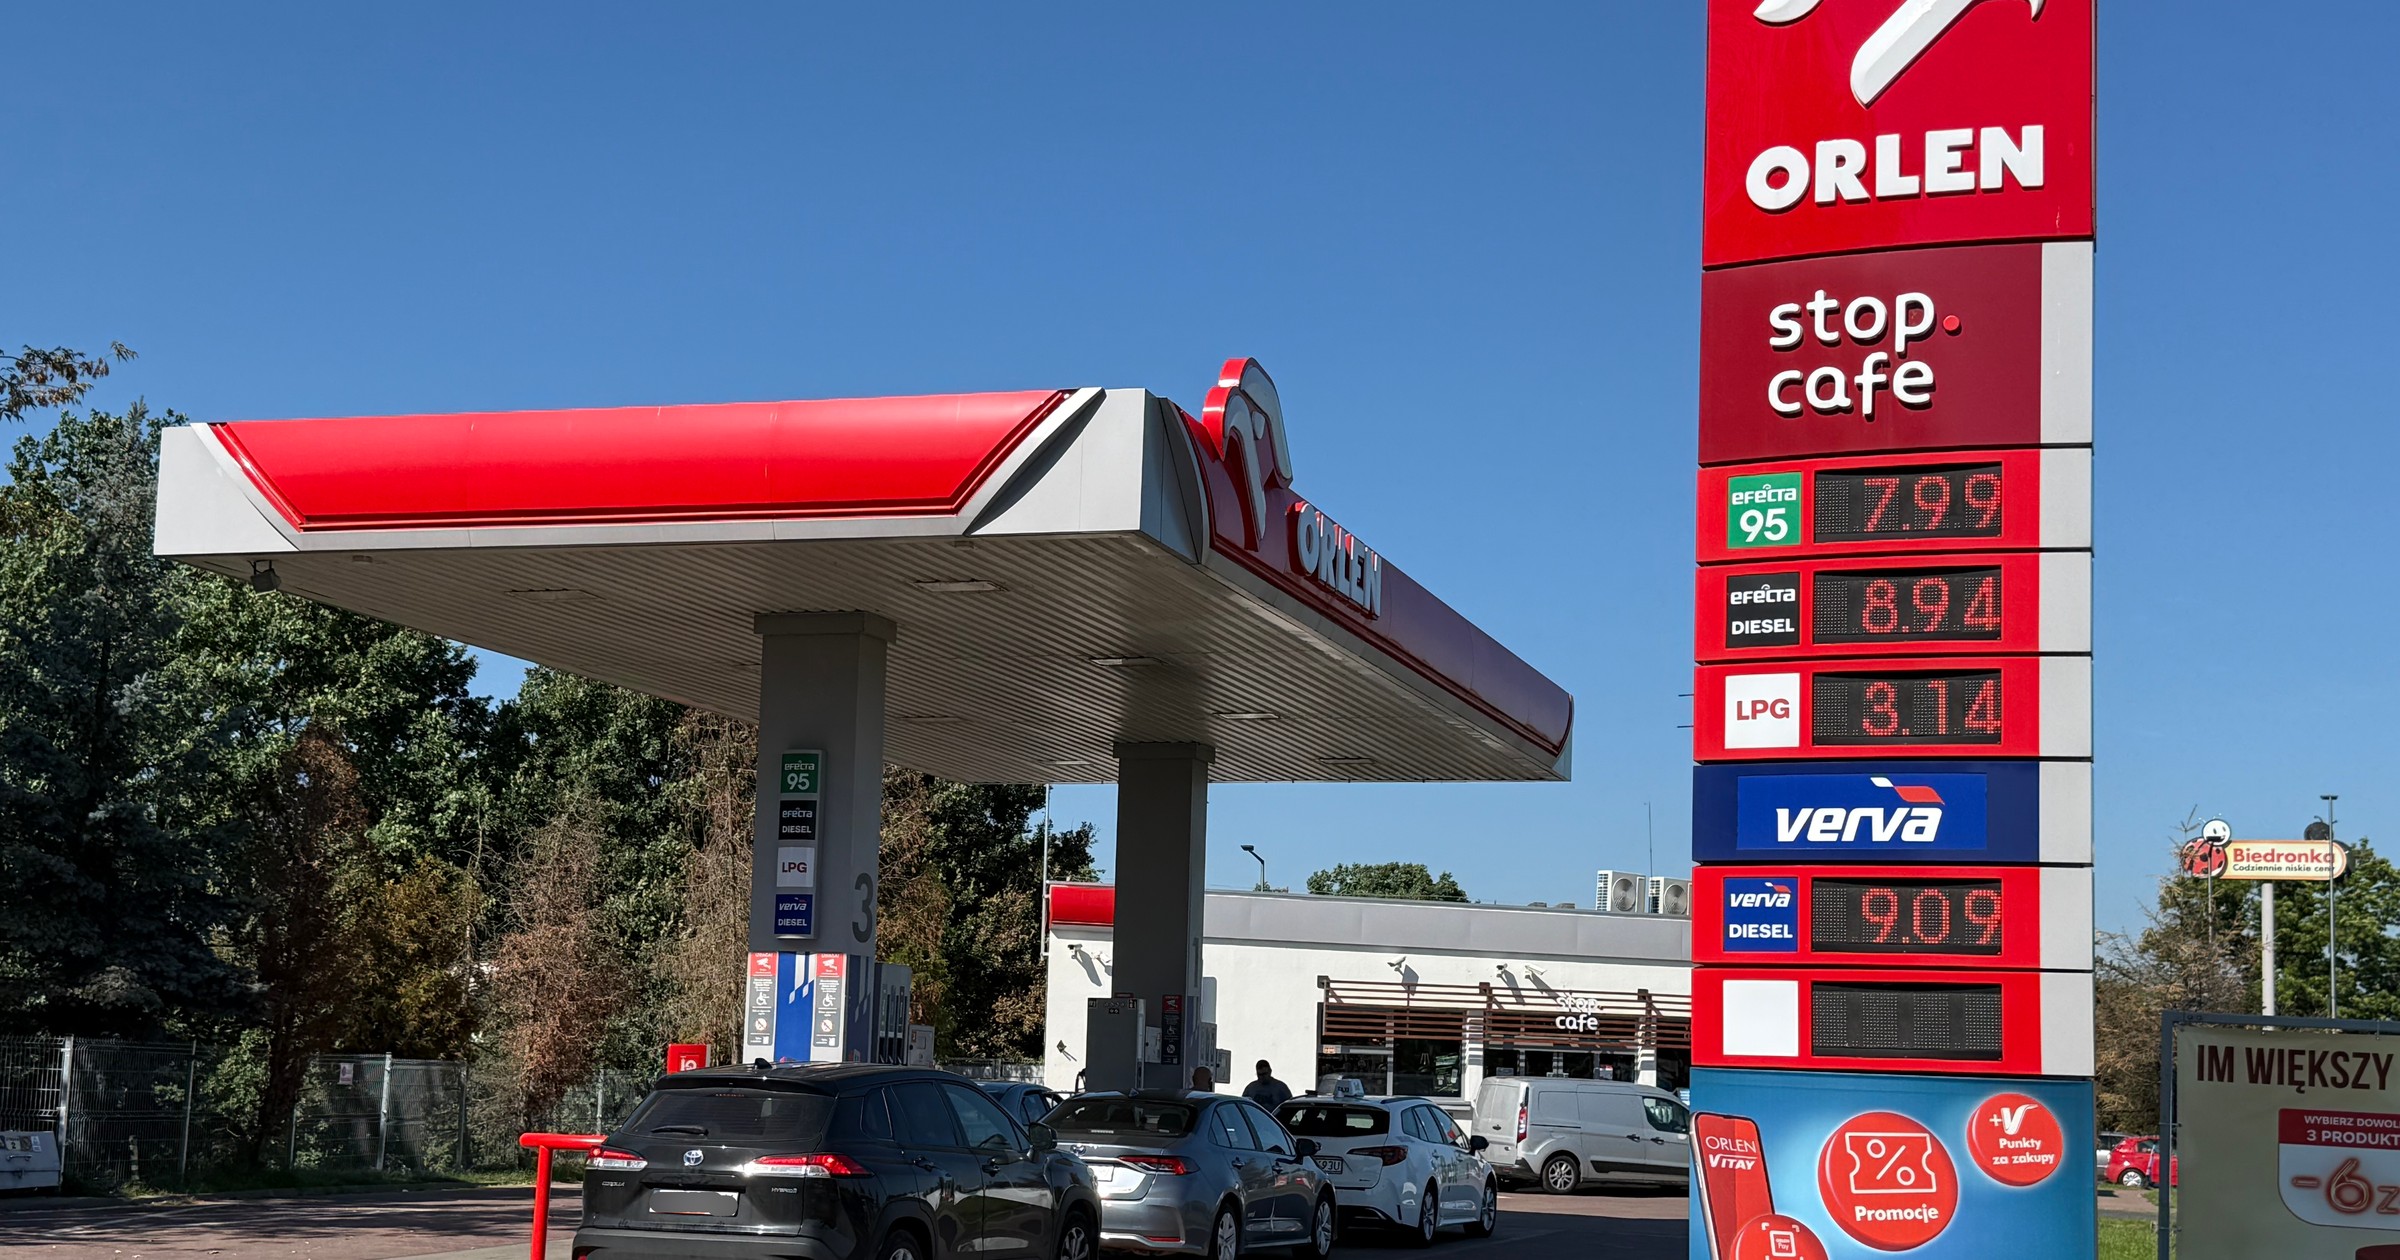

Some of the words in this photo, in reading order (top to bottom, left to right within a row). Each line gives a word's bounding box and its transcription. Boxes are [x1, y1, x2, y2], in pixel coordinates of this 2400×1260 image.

[1746, 125, 2044, 210] ORLEN
[1768, 352, 1934, 416] cafe
[1864, 474, 2000, 532] 7.99
[1739, 508, 1788, 542] 95
[1291, 502, 1381, 617] ORLEN
[1861, 577, 2000, 634] 8.94
[1731, 618, 1795, 635] DIESEL
[1736, 698, 1790, 721] LPG
[1861, 679, 2000, 736] 3.14
[787, 773, 809, 791] 95
[782, 825, 812, 834] DIESEL
[1776, 807, 1943, 843] verva
[2233, 848, 2335, 864] Biedronka
[782, 861, 808, 873] LPG
[2233, 863, 2282, 872] Codziennie
[2285, 863, 2311, 872] niskie
[779, 902, 807, 911] verva
[852, 872, 874, 943] 3
[1730, 891, 1792, 908] verva
[778, 918, 808, 926] DIESEL
[1861, 888, 2000, 945] 9.09
[1729, 923, 1793, 939] DIESEL
[1555, 1013, 1598, 1032] cafe
[2197, 1044, 2235, 1083] IM
[2245, 1047, 2394, 1094] WIĘKSZY
[2304, 1115, 2354, 1127] WYBIERZ
[2356, 1118, 2400, 1129] DOWOL
[2306, 1129, 2317, 1141] 3
[1705, 1136, 1757, 1153] ORLEN
[1999, 1137, 2042, 1151] Punkty
[1708, 1153, 1758, 1170] VITAY
[1992, 1156, 2009, 1165] za
[2011, 1151, 2055, 1165] zakupy
[1854, 1203, 1939, 1224] Promocje
